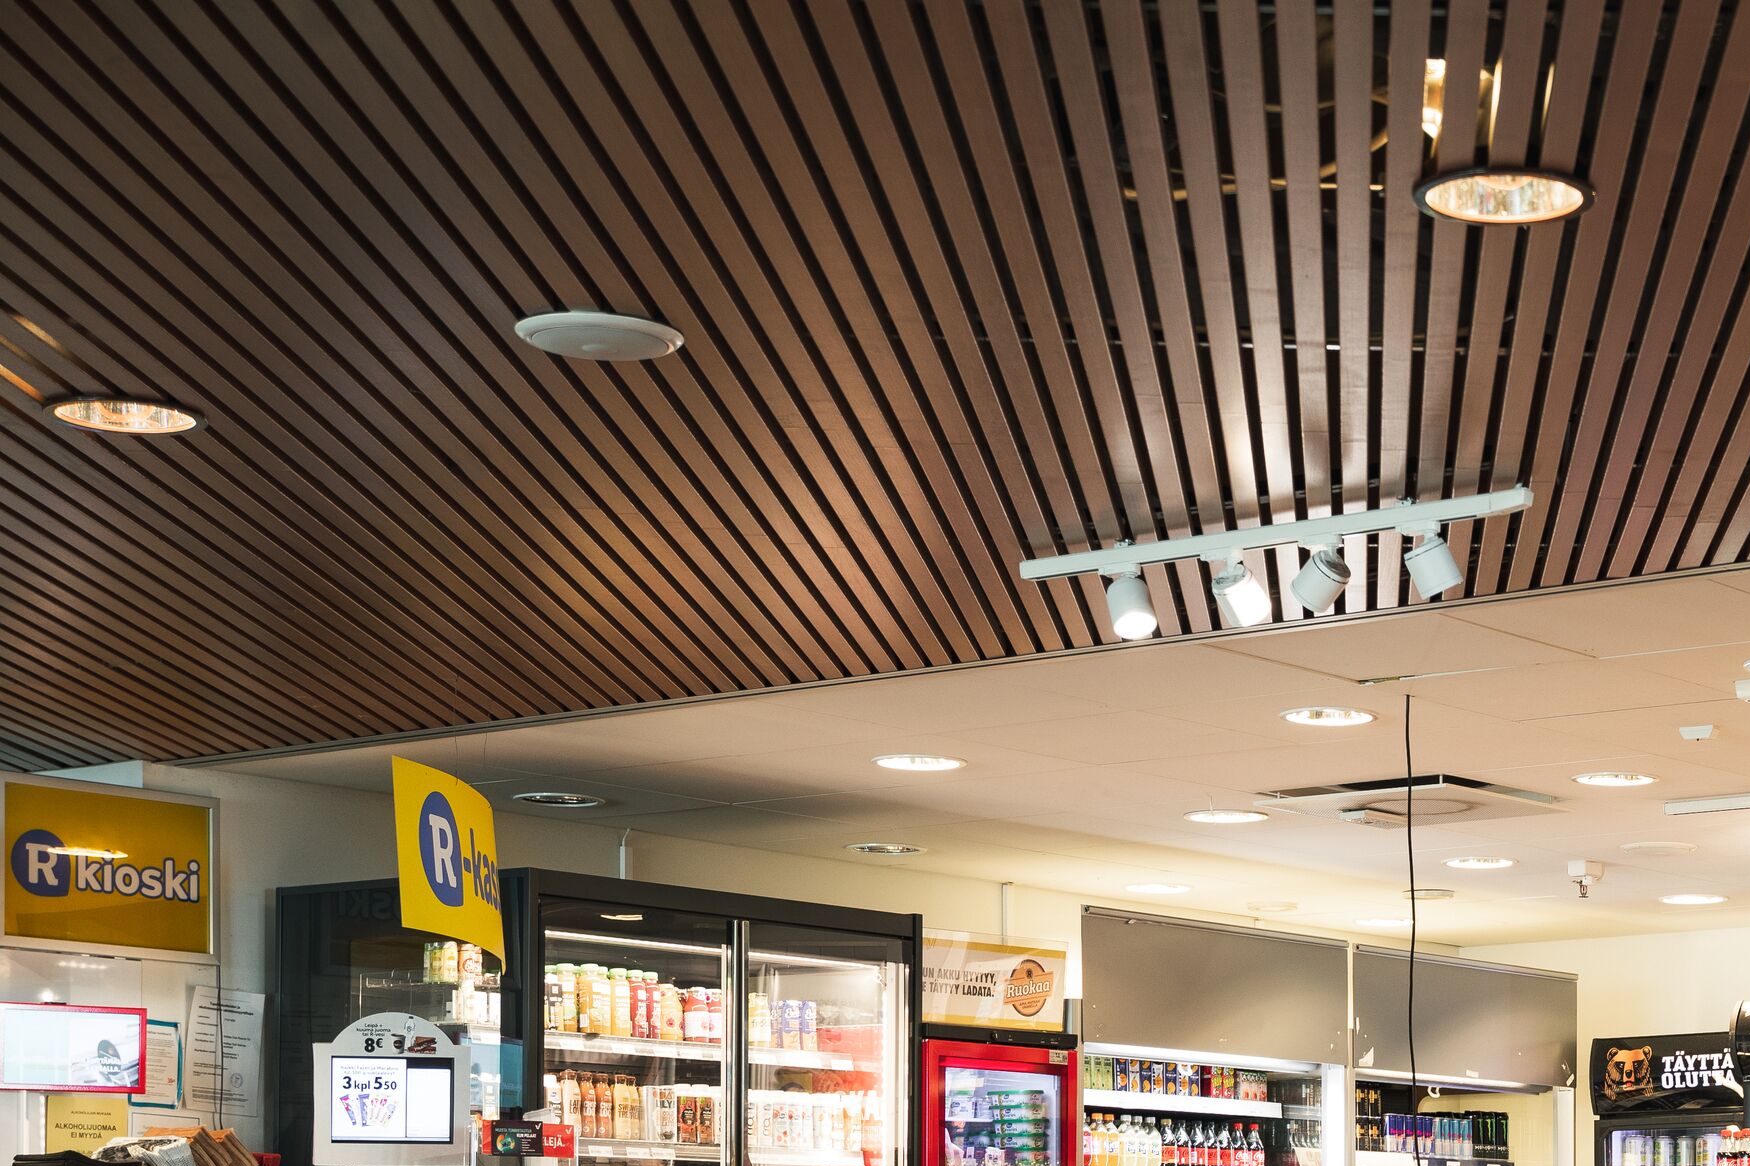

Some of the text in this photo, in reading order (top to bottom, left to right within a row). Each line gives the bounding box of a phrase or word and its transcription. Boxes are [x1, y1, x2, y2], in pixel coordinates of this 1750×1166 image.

[25, 842, 199, 902] R kioski
[961, 984, 995, 997] LADATA.
[1006, 980, 1050, 998] Ruokaa
[364, 1037, 384, 1053] 8€
[1661, 1047, 1735, 1072] TÄYTTÄ
[342, 1075, 371, 1092] 3 kpl
[1660, 1067, 1738, 1090] OLUTTA
[54, 1122, 117, 1132] ALKOHOLIJUOMAA
[70, 1131, 77, 1139] EI
